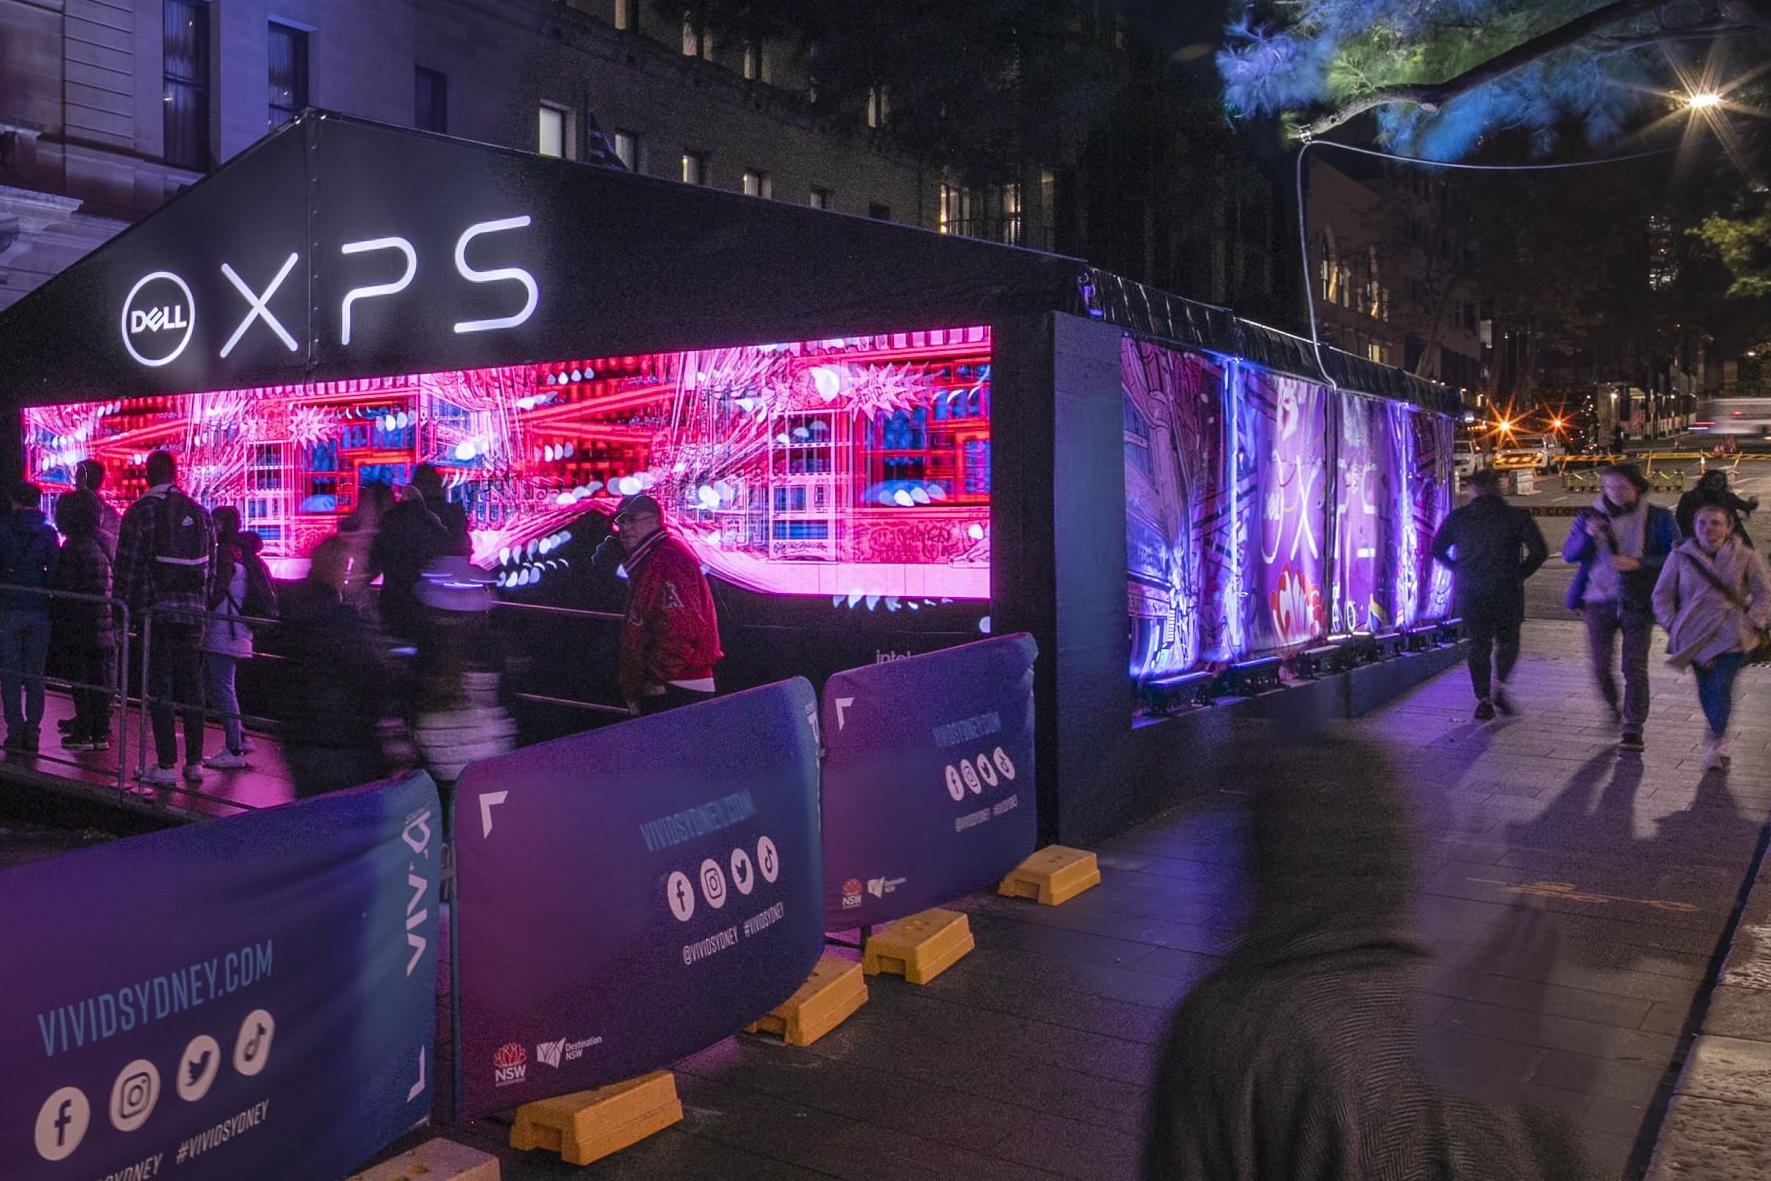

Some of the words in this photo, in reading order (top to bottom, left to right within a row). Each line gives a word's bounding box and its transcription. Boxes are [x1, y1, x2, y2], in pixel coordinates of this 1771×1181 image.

[130, 304, 188, 334] DELL
[219, 214, 541, 359] XPS
[842, 894, 862, 906] NSW
[682, 925, 739, 965] @VIVIDSYDNEY
[743, 901, 785, 938] #VIVIDSYDNEY
[37, 938, 273, 1057] VIVIDSYDNEY.COM
[565, 1036, 602, 1052] Destination
[565, 1049, 583, 1061] NSW
[494, 1064, 526, 1082] NSW
[175, 1099, 270, 1165] #VIVIDSYDNEY
